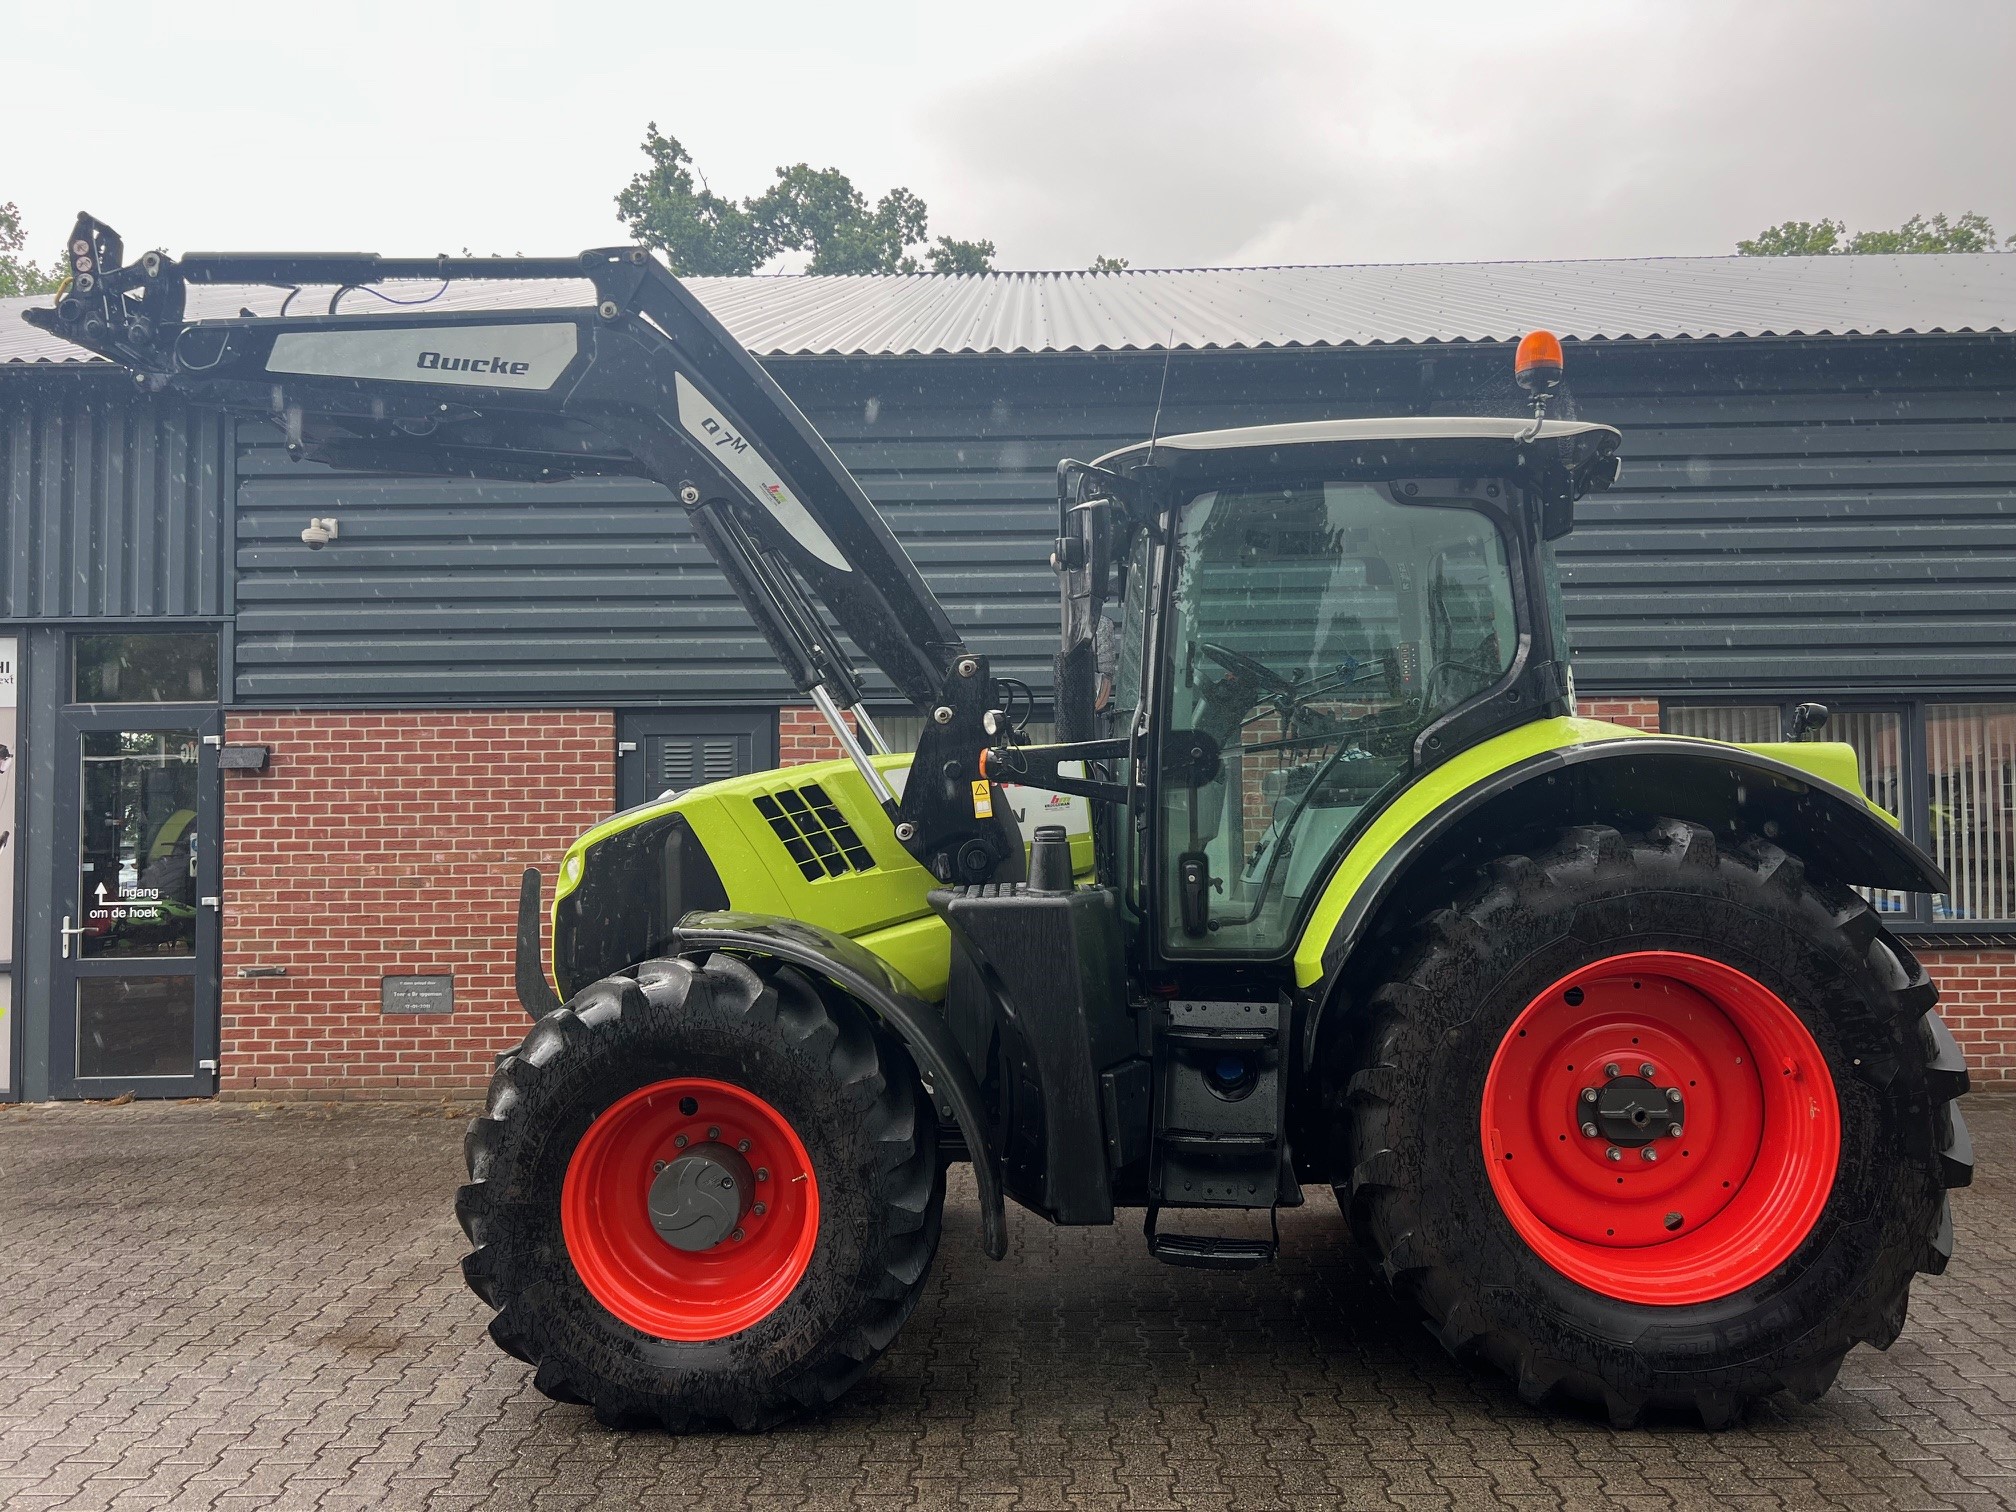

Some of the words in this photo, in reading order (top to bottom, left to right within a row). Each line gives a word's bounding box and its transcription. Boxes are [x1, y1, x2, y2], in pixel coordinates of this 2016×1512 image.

[417, 352, 530, 375] Quicke
[118, 886, 159, 899] Ingang
[89, 909, 108, 919] om
[111, 907, 127, 918] de
[129, 906, 159, 918] hoek
